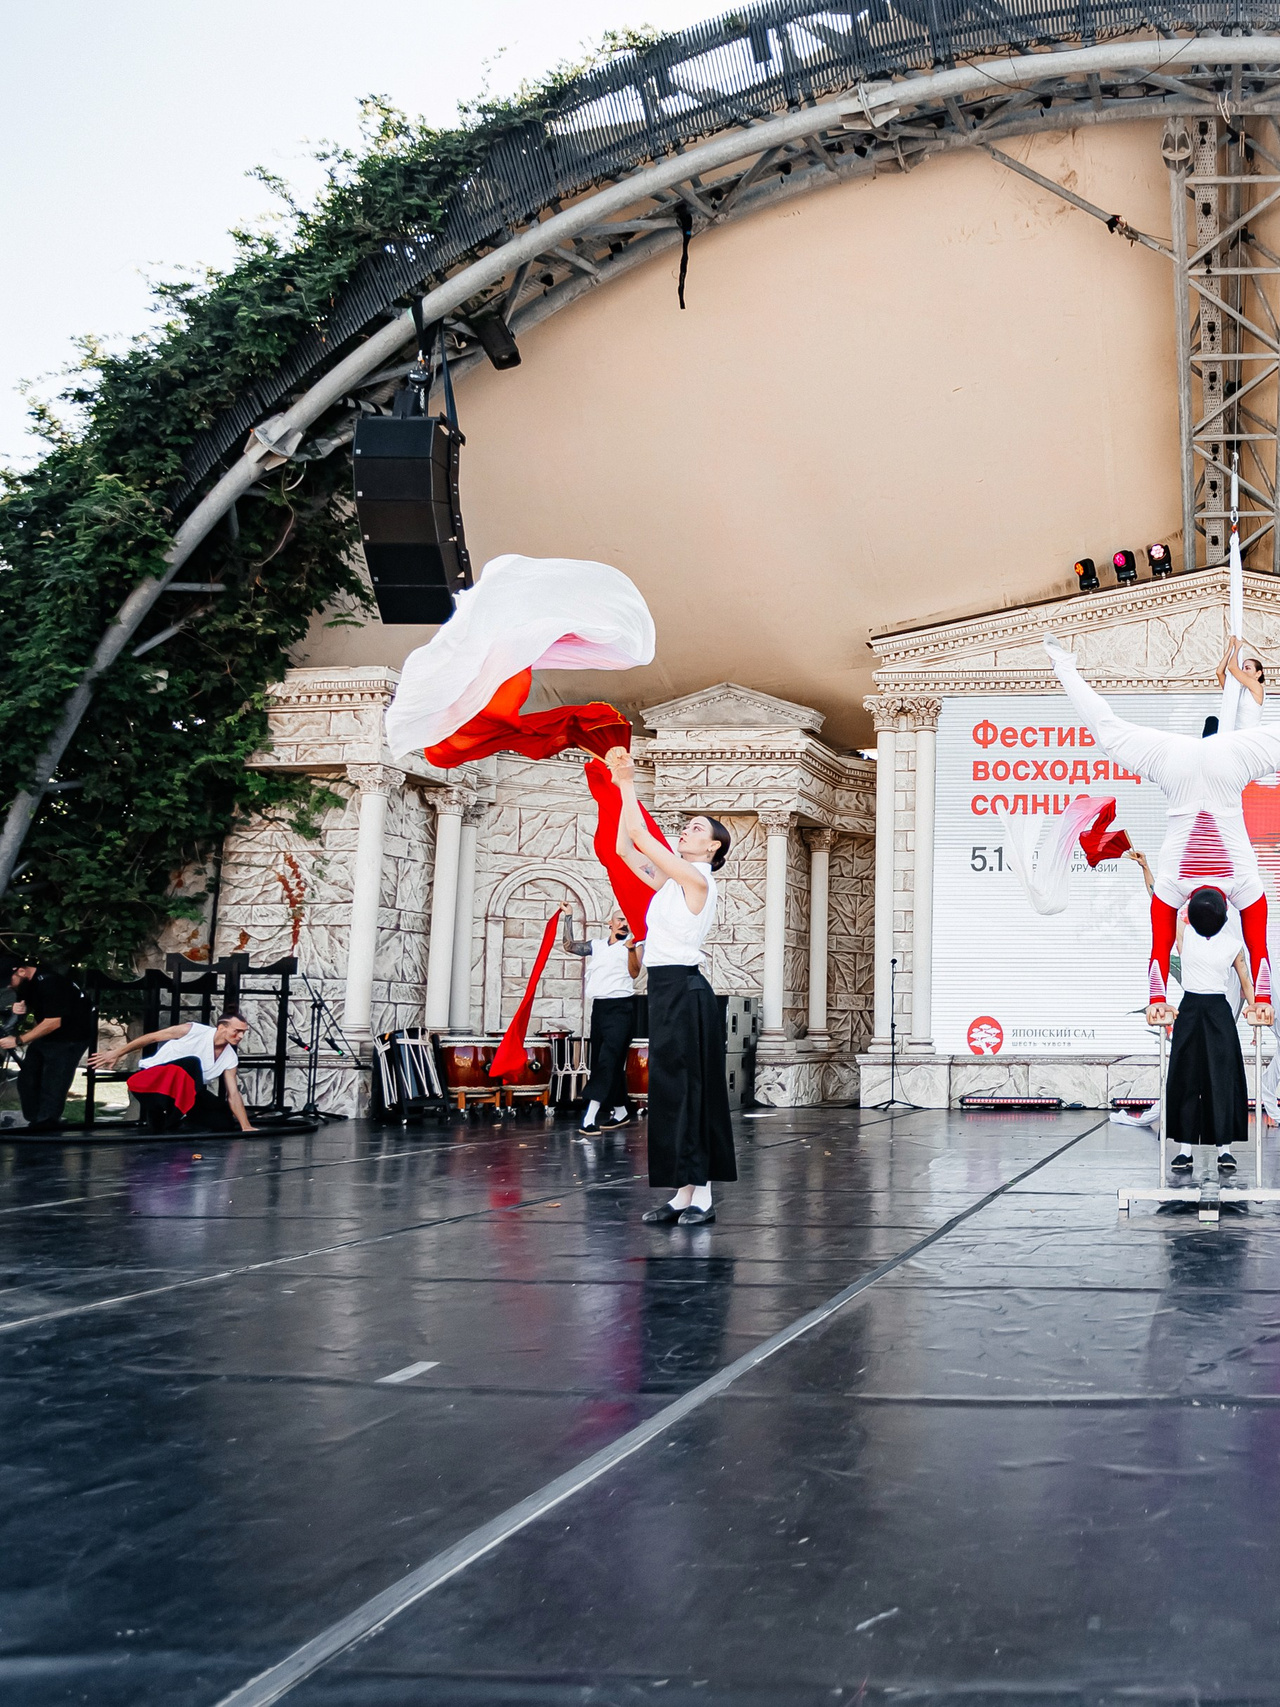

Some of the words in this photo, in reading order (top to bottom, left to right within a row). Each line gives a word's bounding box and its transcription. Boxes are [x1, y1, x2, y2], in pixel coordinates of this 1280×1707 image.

[970, 793, 1092, 816] солнц
[970, 846, 1013, 872] 5.1
[1011, 1026, 1071, 1038] ЯПОНСКИЙ
[1073, 1028, 1096, 1040] САД
